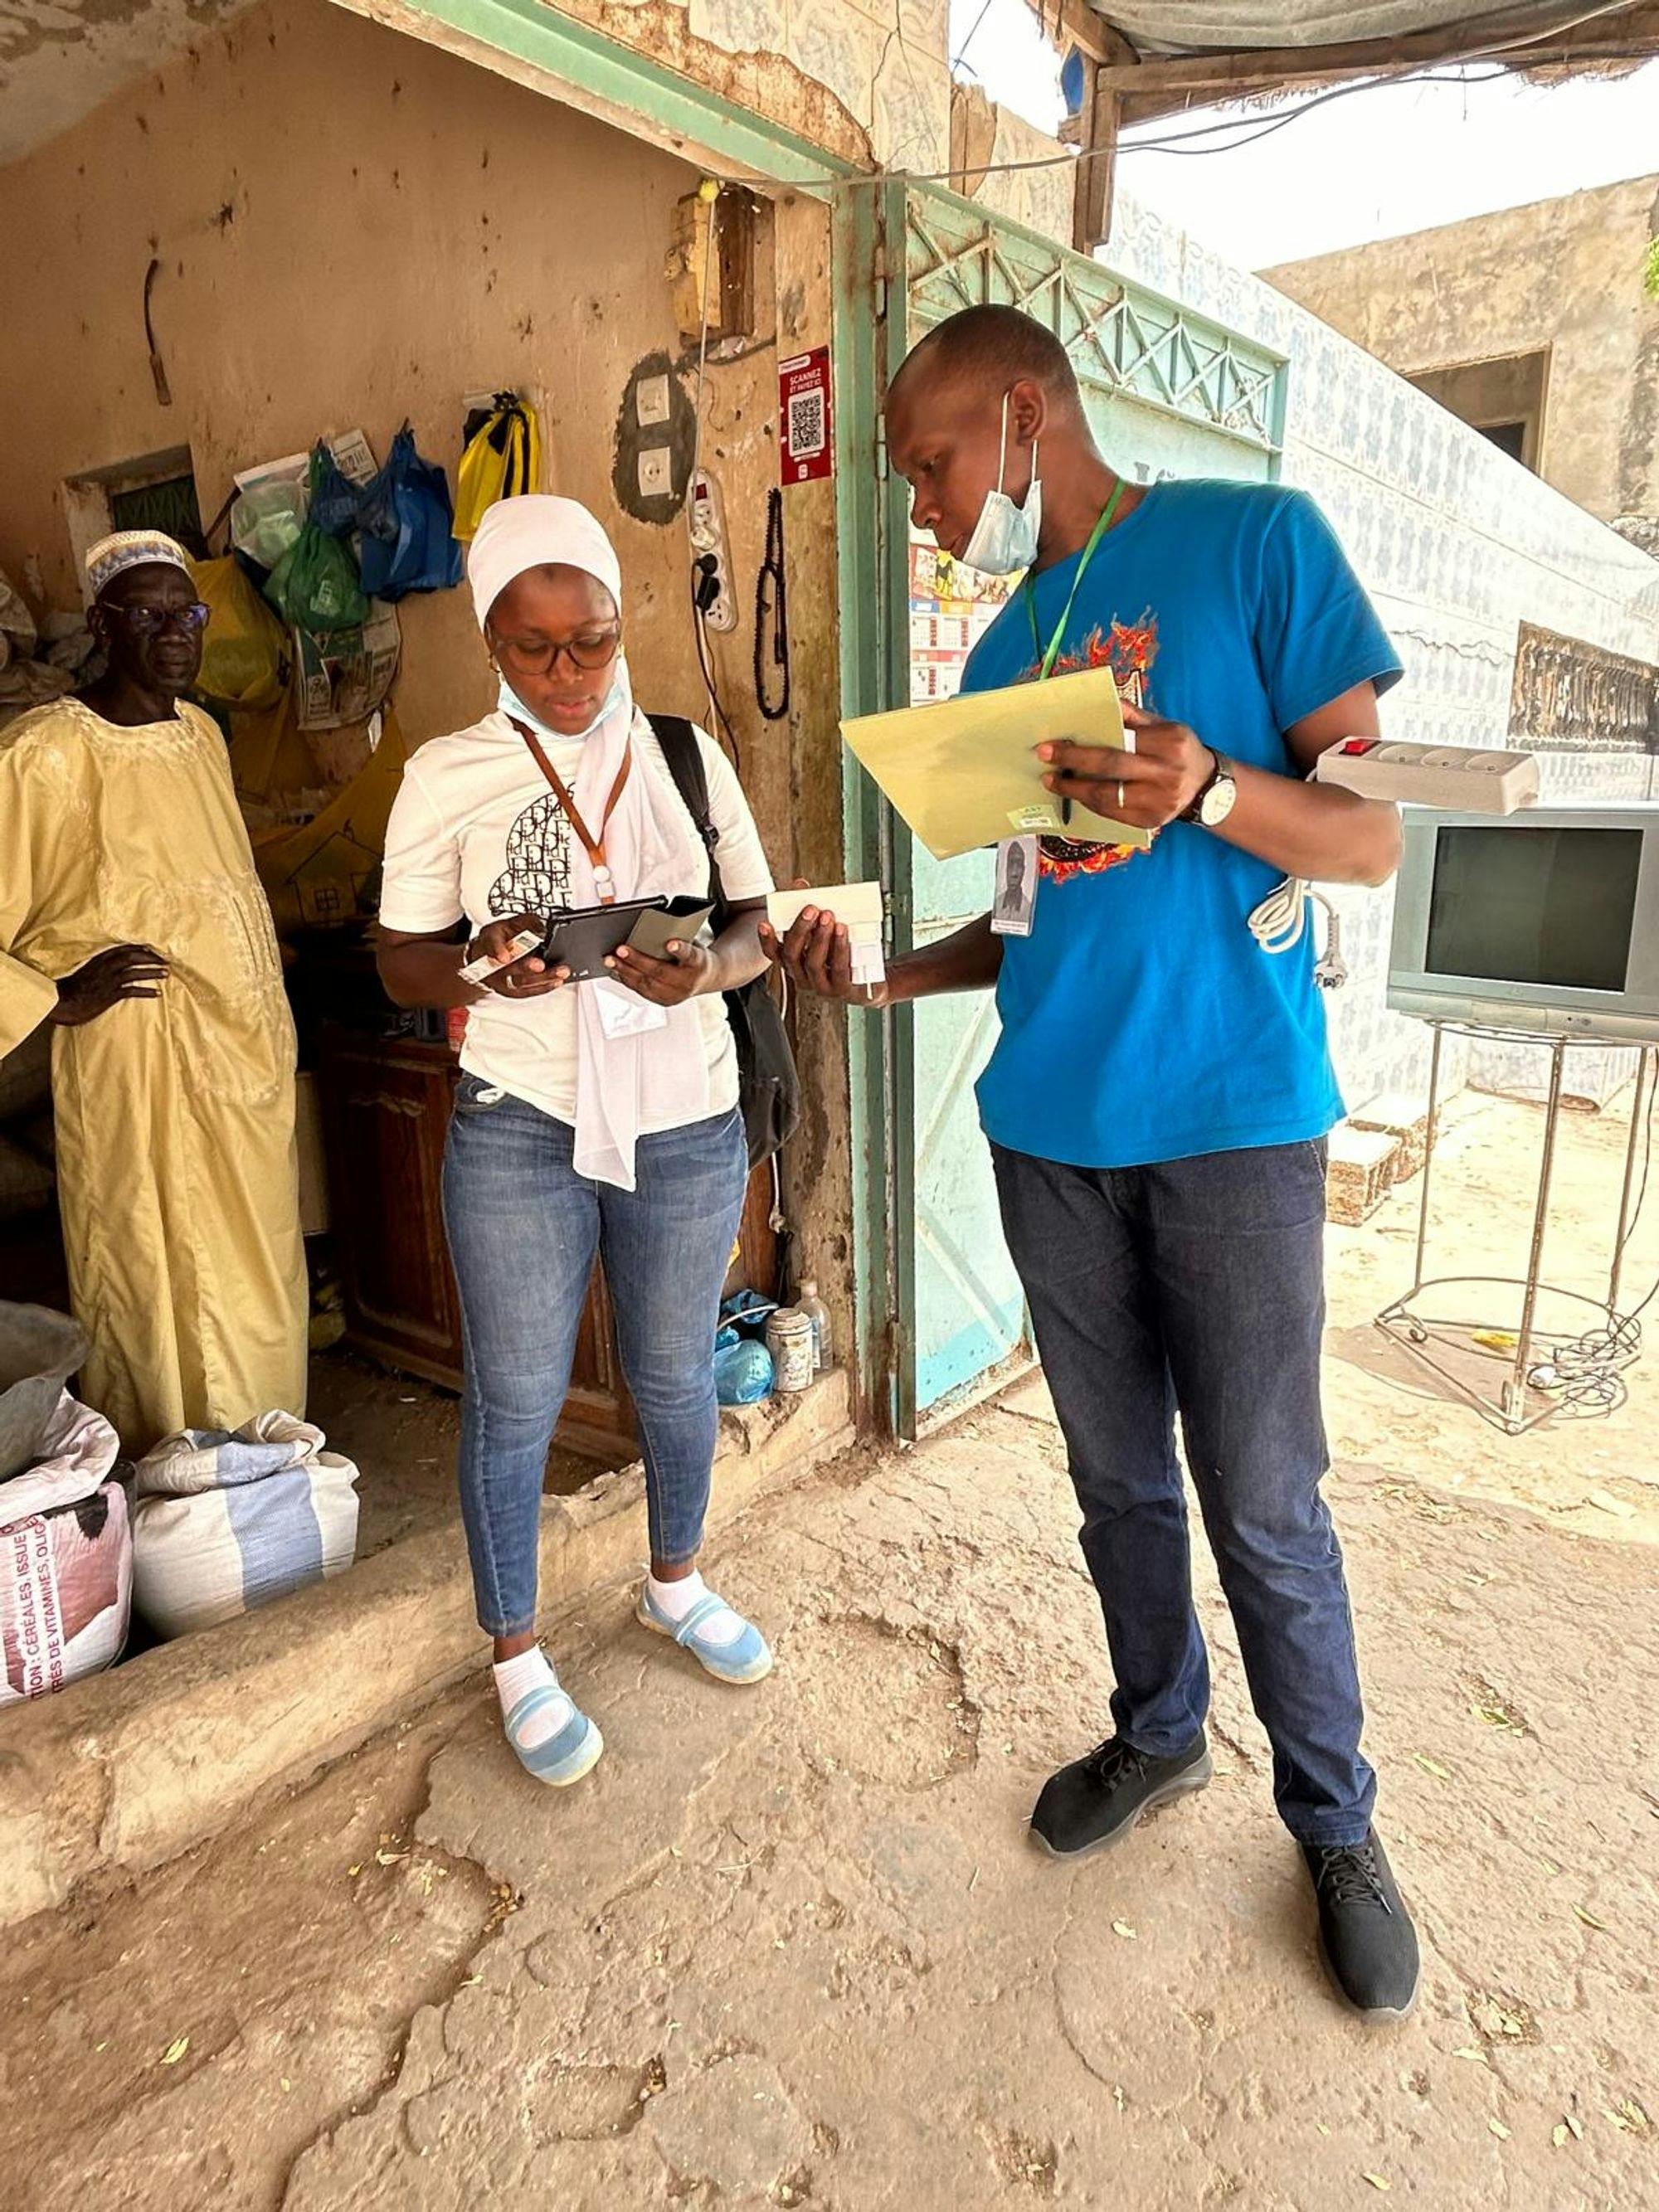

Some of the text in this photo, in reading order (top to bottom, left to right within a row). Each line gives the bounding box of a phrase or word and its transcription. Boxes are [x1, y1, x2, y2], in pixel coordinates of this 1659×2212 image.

[790, 367, 821, 386] SCANNEZ
[13, 1534, 30, 1577] ISSUE
[48, 1638, 61, 1659] DE
